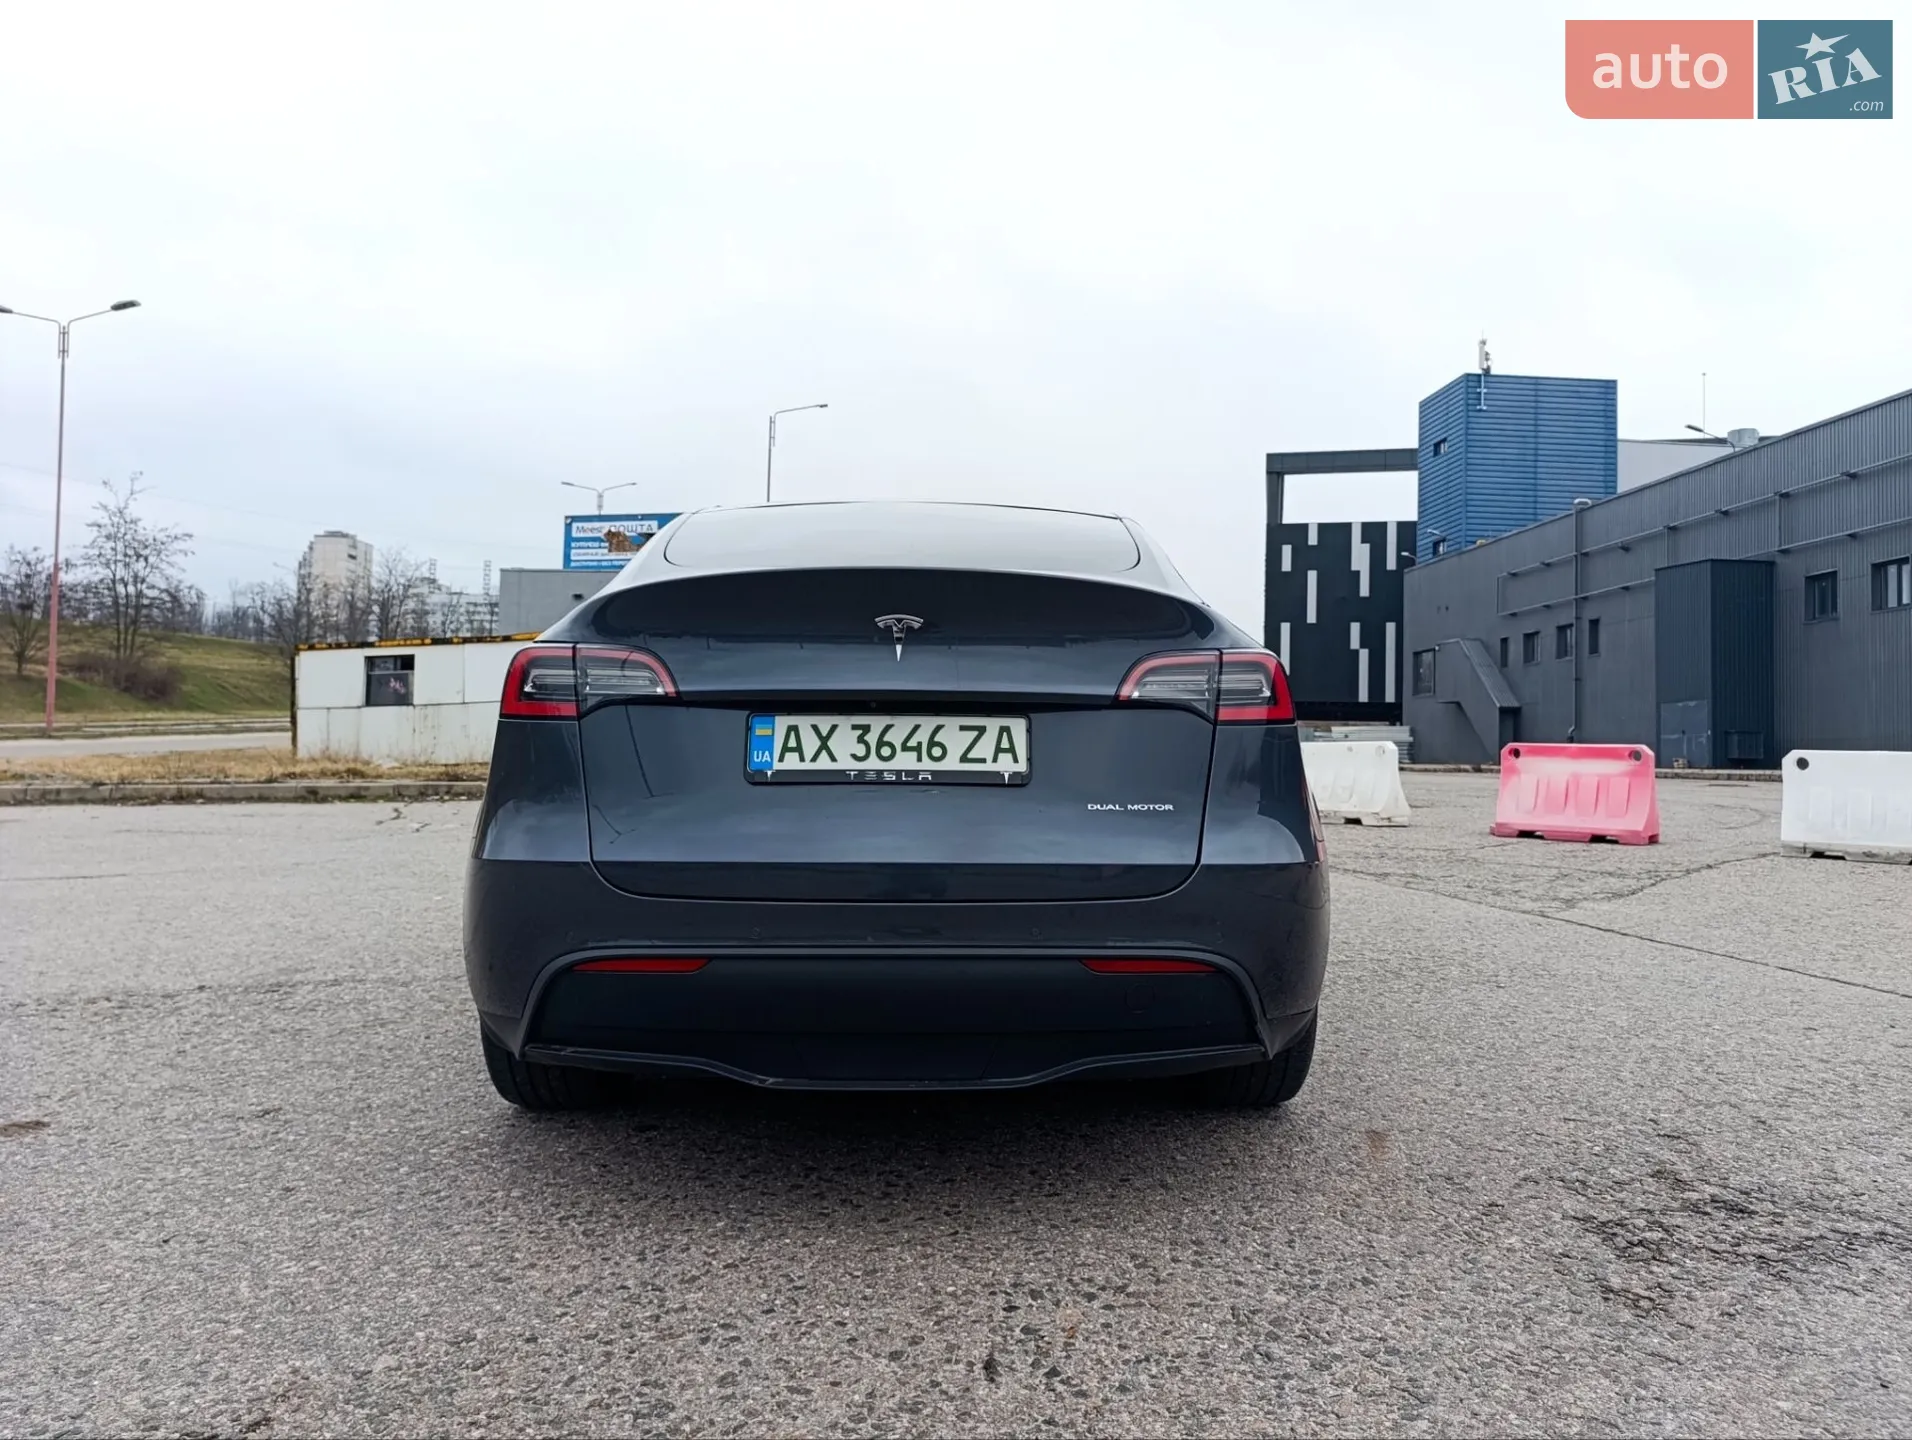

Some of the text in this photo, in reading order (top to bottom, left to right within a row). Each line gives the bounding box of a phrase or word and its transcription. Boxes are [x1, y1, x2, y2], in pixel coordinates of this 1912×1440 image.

[777, 724, 1020, 764] AX 3646 ZA
[753, 752, 771, 763] UA
[845, 771, 932, 781] TESLA
[1087, 803, 1174, 811] DUAL MOTOR
